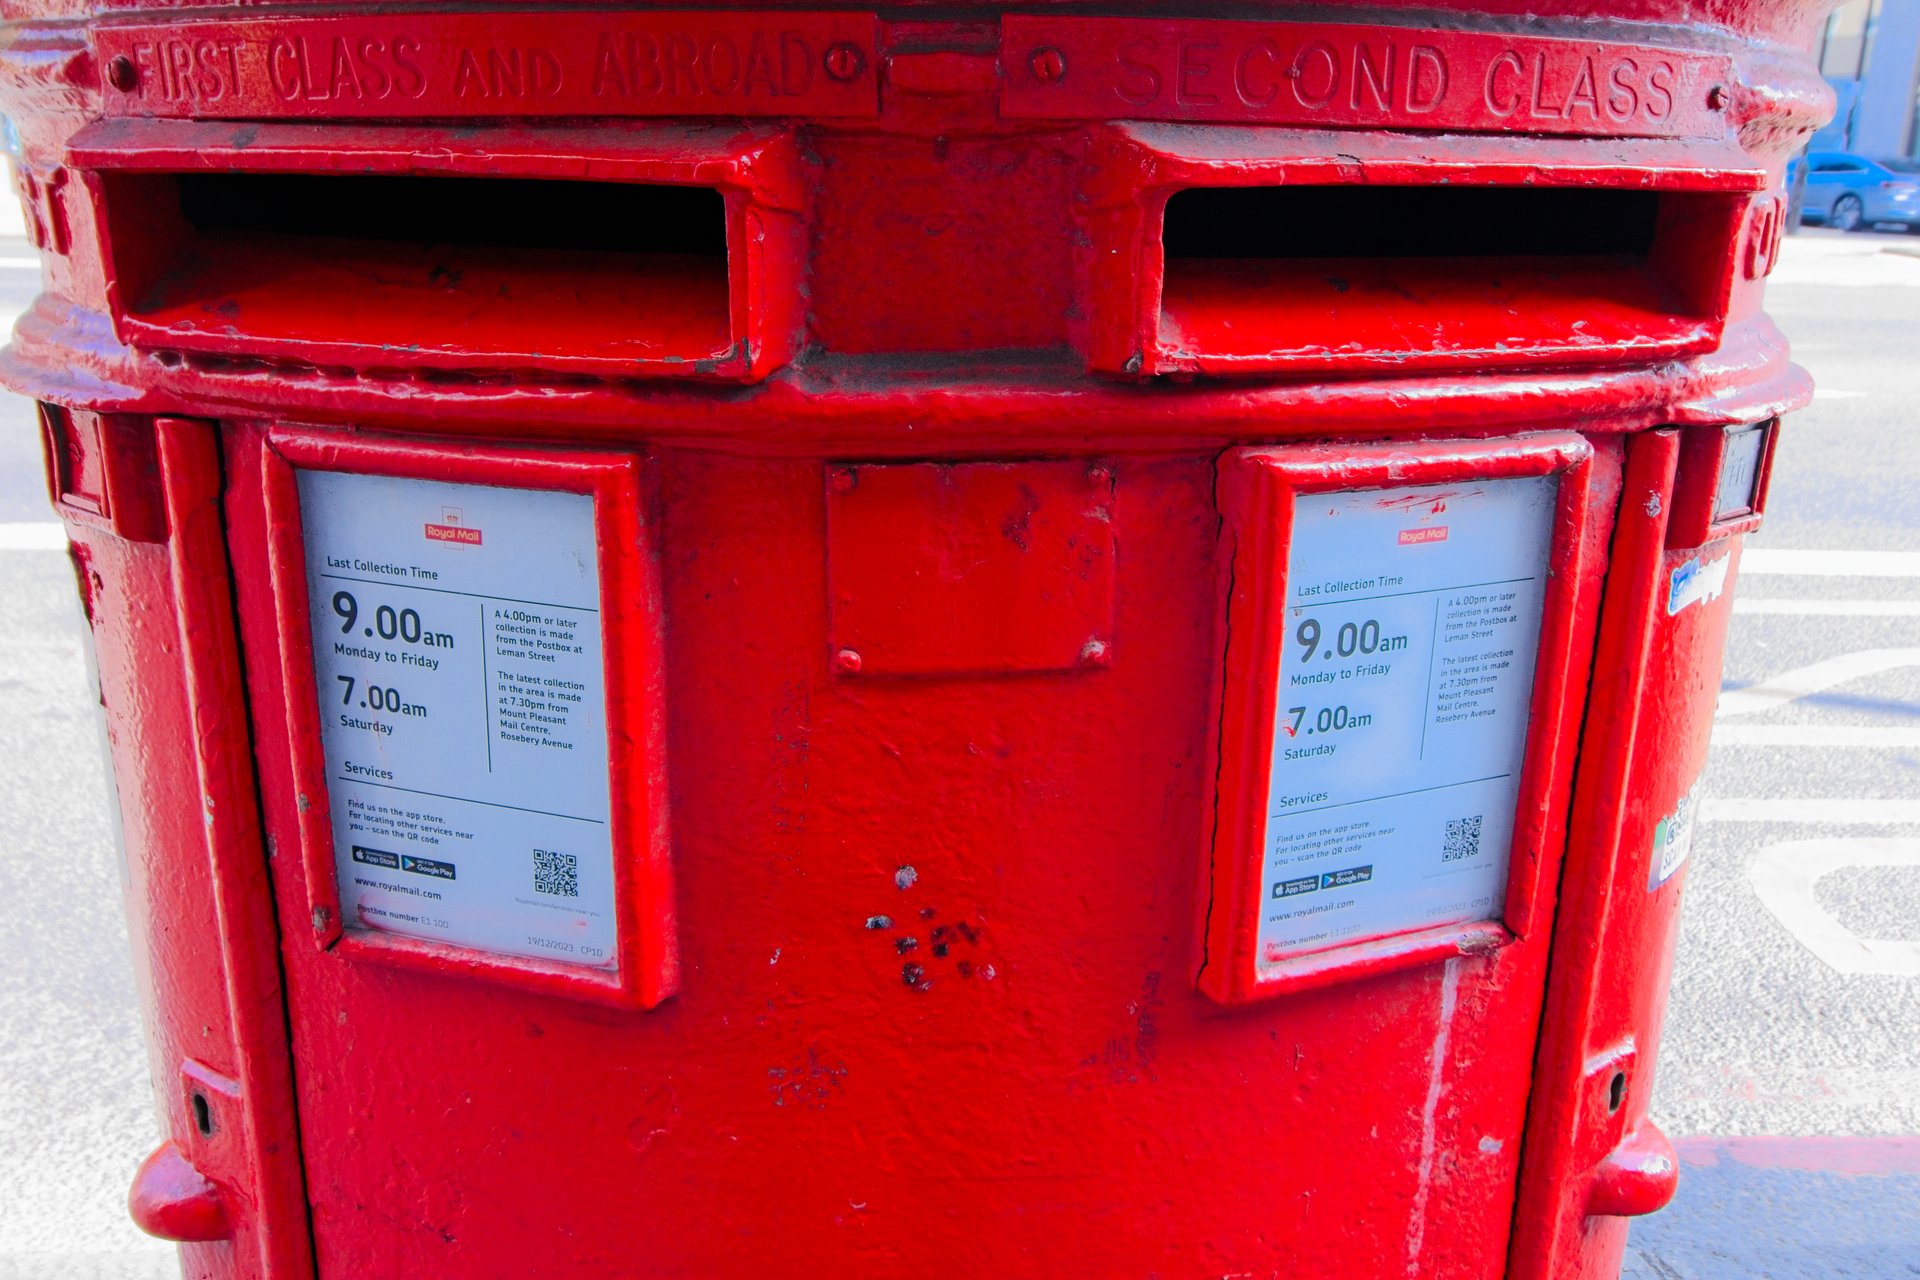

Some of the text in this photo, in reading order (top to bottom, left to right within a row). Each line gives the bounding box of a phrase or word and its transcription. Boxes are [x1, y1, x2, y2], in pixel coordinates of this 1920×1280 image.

[132, 30, 817, 102] FIRST CLASS AND ABROAD
[1113, 34, 1674, 125] SECOND CLASS
[427, 526, 479, 541] Royal Mail
[1400, 527, 1447, 543] Royal Mail
[327, 555, 438, 581] Last Collection Time
[1298, 575, 1404, 597] Last Collection Time
[1448, 599, 1453, 607] A
[1456, 594, 1488, 606] 4.00pm
[1499, 592, 1517, 601] later
[495, 609, 577, 628] A 4.00pm or later
[1447, 603, 1512, 620] collection is made
[495, 623, 574, 641] collection is made
[1446, 614, 1517, 631] from the Postbox at
[496, 633, 583, 654] from the Postbox at
[1444, 628, 1494, 643] Leman Street
[334, 641, 439, 671] Monday to Friday
[497, 645, 555, 663] Leman Street
[1442, 648, 1514, 666] The latest collection
[1291, 663, 1391, 687] Monday to Friday
[1441, 660, 1510, 677] in the area is made
[497, 670, 585, 691] The latest collection
[1439, 674, 1498, 690] at 7.30pm from
[498, 682, 582, 703] in the area is made
[1438, 685, 1494, 701] Mount Pleasant
[499, 696, 569, 714] at 7.30pm from
[1437, 702, 1453, 713] Mail
[340, 714, 393, 736] Saturday
[499, 706, 567, 726] Mount Pleasant
[500, 719, 518, 730] Mail
[1436, 708, 1496, 725] Rosebery Avenue
[501, 730, 573, 750] Rosebery Avenue
[1284, 743, 1337, 761] Saturday
[344, 760, 393, 780] Services
[1280, 791, 1328, 808] Services
[347, 799, 364, 810] Find
[367, 804, 377, 812] us
[378, 806, 388, 814] on
[390, 807, 404, 817] the
[406, 811, 421, 821] app
[348, 809, 474, 840] For locating other services near
[349, 822, 364, 831] you
[372, 826, 390, 836] scan
[392, 829, 405, 839] the
[407, 831, 419, 842] QR
[421, 835, 439, 845] code
[1276, 833, 1294, 844] Find
[1295, 832, 1305, 841] us
[1307, 830, 1317, 839] on
[1319, 827, 1332, 836] the
[1334, 825, 1349, 834] app
[1274, 827, 1395, 855] For locating other services near
[1274, 858, 1289, 868] you
[1297, 853, 1315, 863] scan
[1317, 849, 1330, 859] the
[1332, 845, 1343, 856] QR
[1345, 843, 1362, 853] code
[354, 876, 442, 901] www.royalmail.com
[357, 903, 387, 917] Postbox
[389, 911, 420, 923] number
[1269, 899, 1355, 923] www.royalmail.com
[527, 935, 574, 953] 19/12/2023
[1266, 936, 1297, 951] Postbox
[1298, 931, 1327, 944] number
